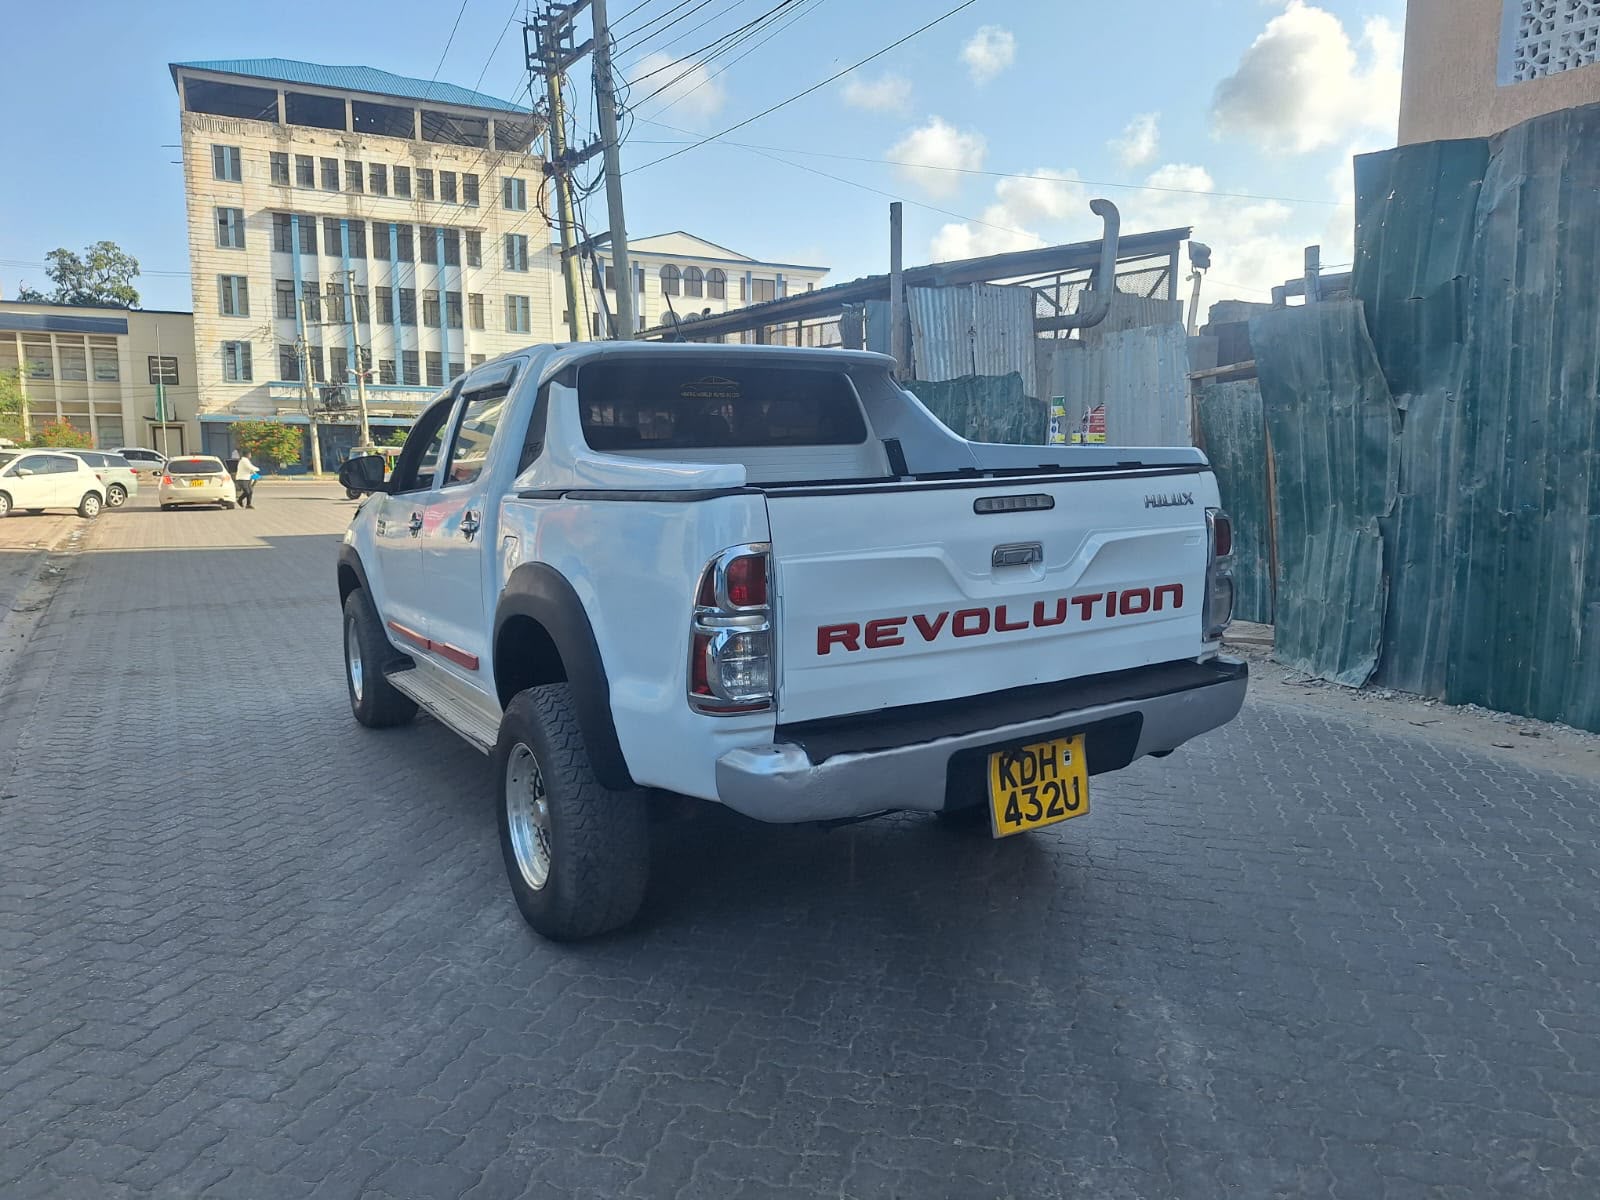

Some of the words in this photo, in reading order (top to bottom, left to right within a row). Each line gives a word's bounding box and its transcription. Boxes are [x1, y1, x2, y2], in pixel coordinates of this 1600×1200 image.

[1144, 491, 1194, 509] HILUX
[816, 583, 1184, 655] REVOLUTION
[998, 745, 1058, 792] KDH
[1004, 776, 1080, 827] 432U
